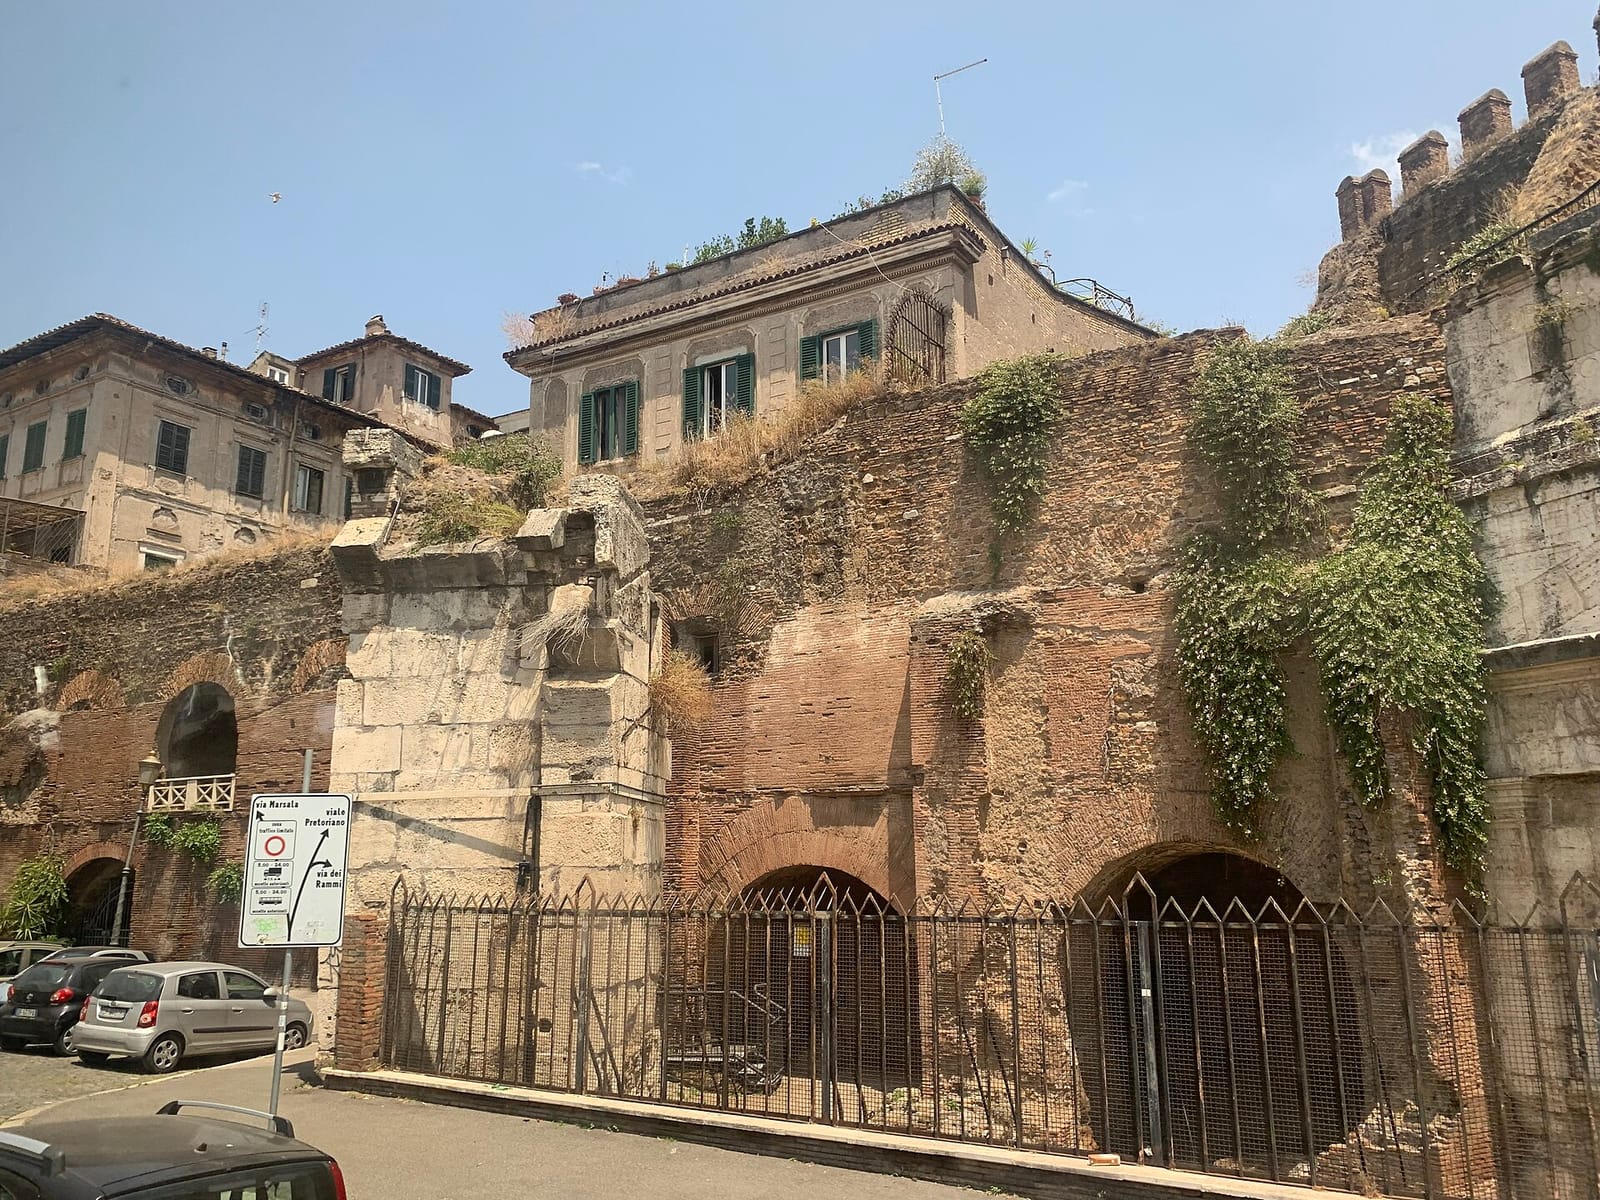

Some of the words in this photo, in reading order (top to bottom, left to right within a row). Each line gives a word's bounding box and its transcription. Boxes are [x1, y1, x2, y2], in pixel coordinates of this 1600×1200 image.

[256, 800, 267, 808] via
[269, 800, 299, 808] Marsala
[326, 808, 345, 816] viale
[305, 818, 345, 826] Pretoriano
[317, 869, 328, 877] via
[330, 869, 342, 877] dei
